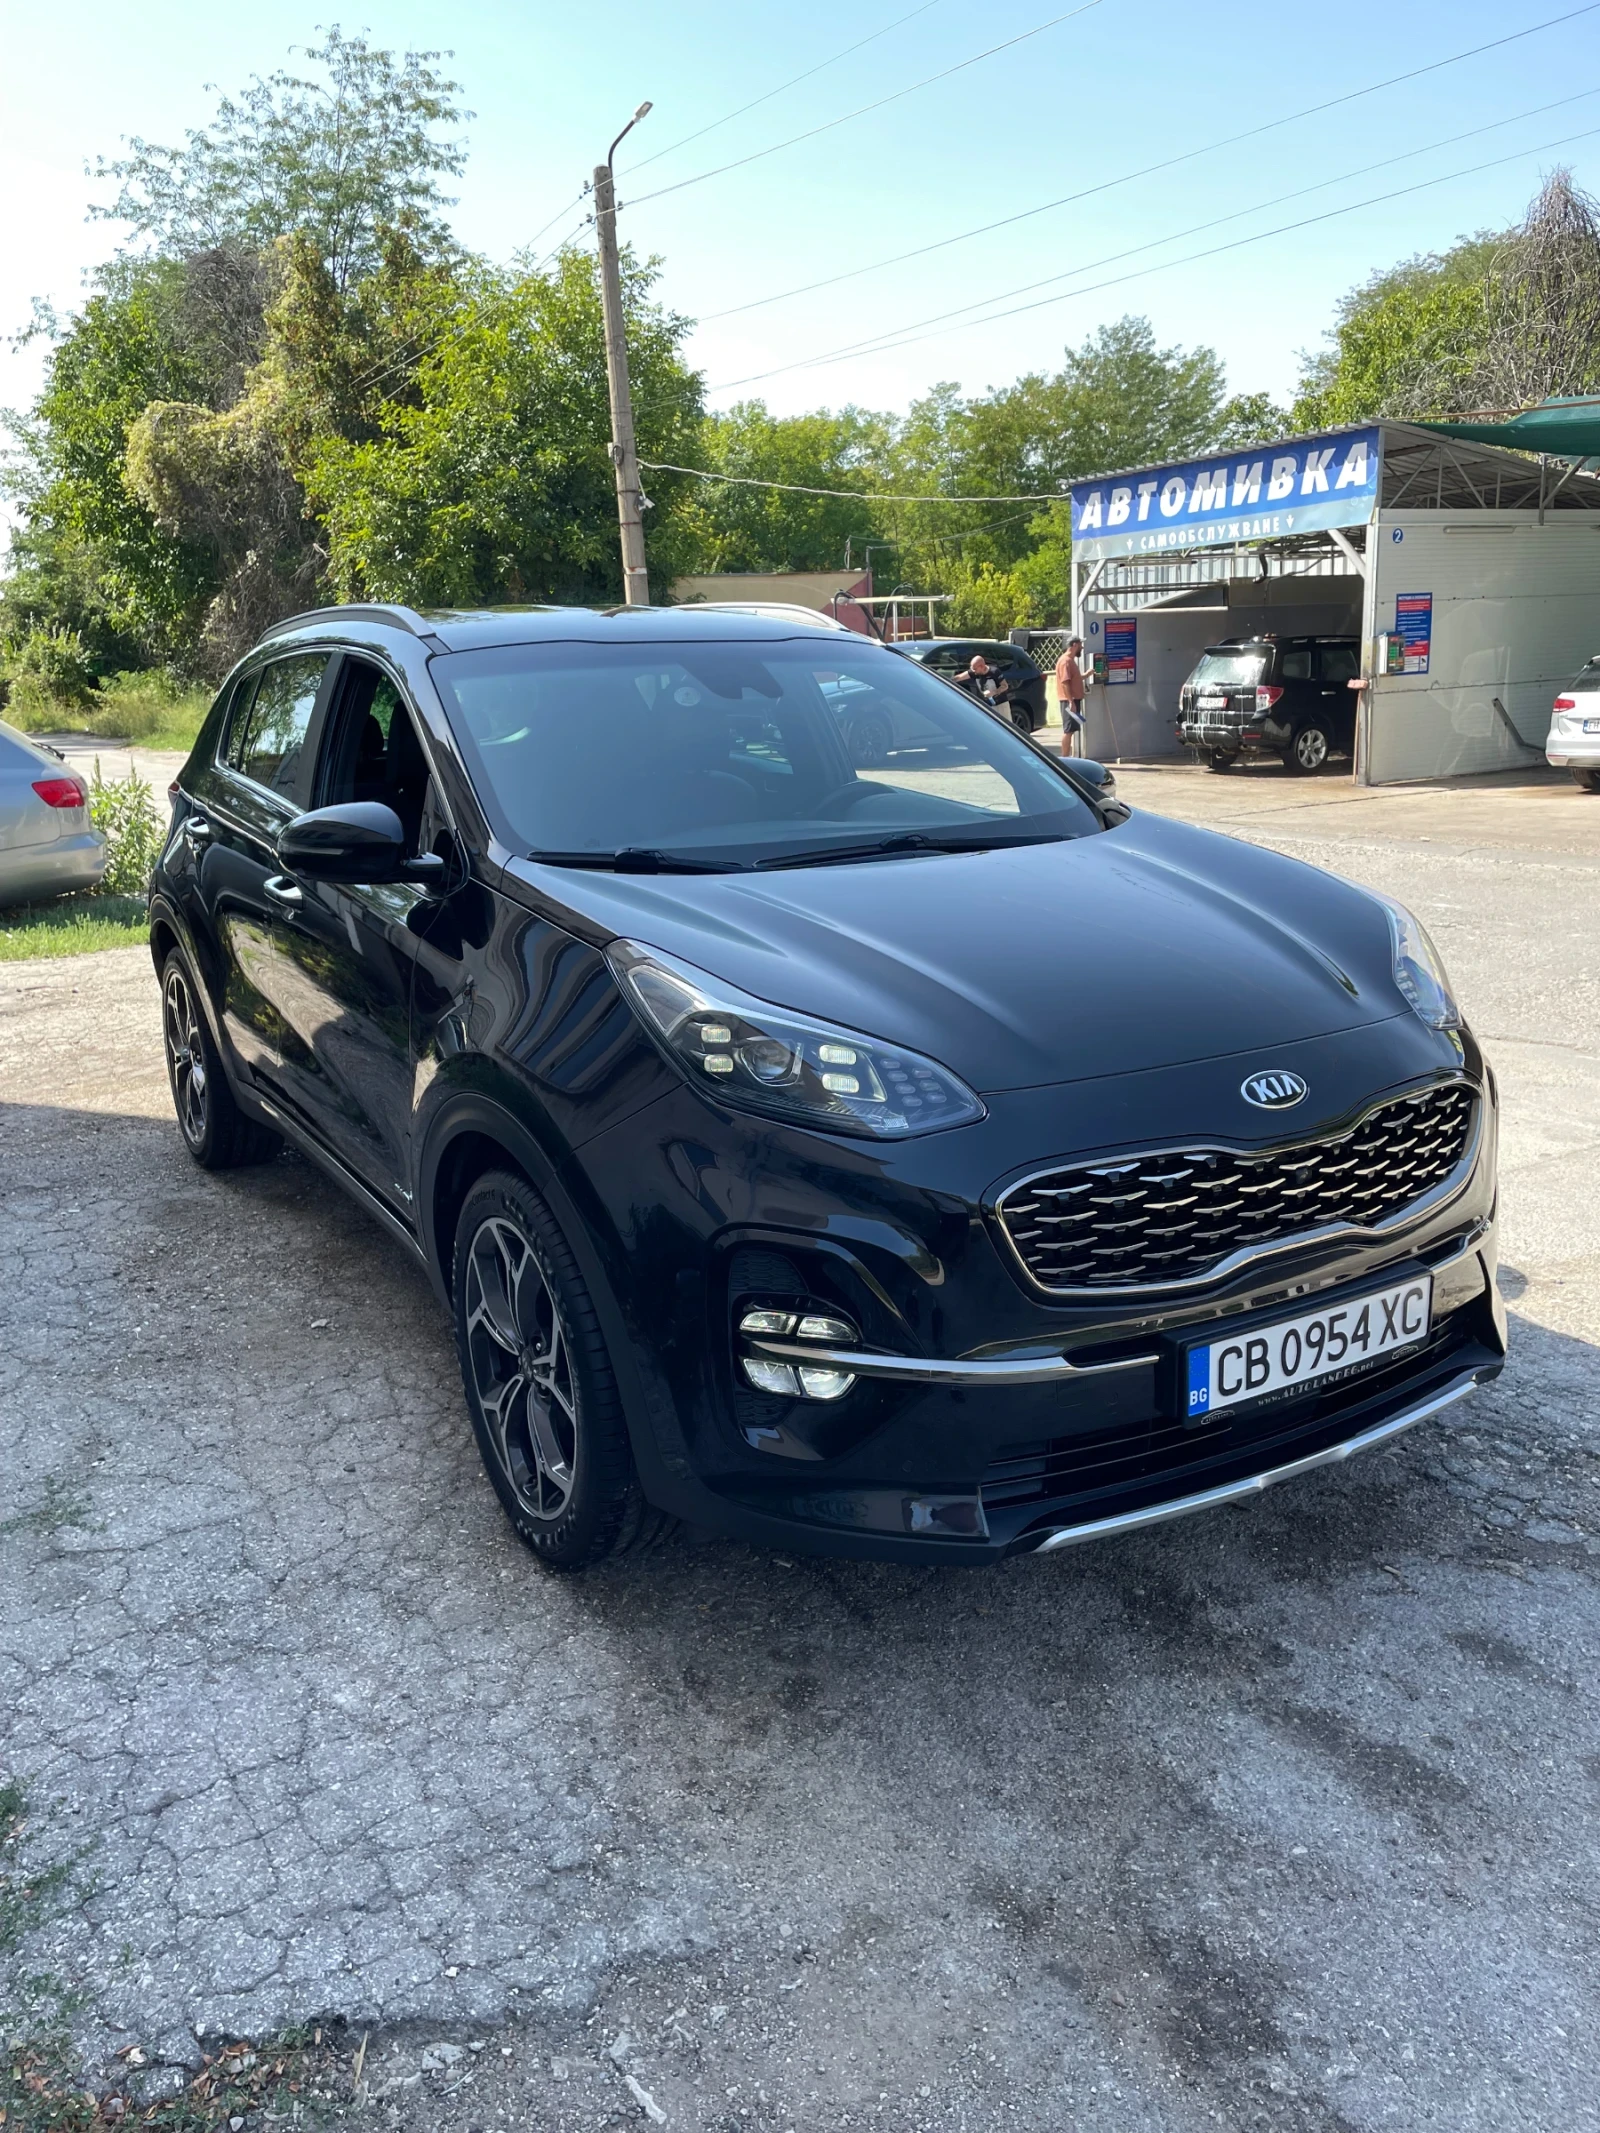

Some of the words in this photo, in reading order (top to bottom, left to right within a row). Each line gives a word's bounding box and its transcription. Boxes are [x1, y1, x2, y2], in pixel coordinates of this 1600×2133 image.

[1078, 442, 1368, 531] АВТОМИВКА
[1140, 517, 1280, 550] САМООБСЛУЖВАНЕ
[1393, 528, 1401, 542] 2
[1250, 1074, 1302, 1102] KIA
[1218, 1338, 1270, 1397] CB
[1281, 1304, 1371, 1377] 0954
[1379, 1287, 1423, 1345] XC
[1190, 1387, 1208, 1406] BG
